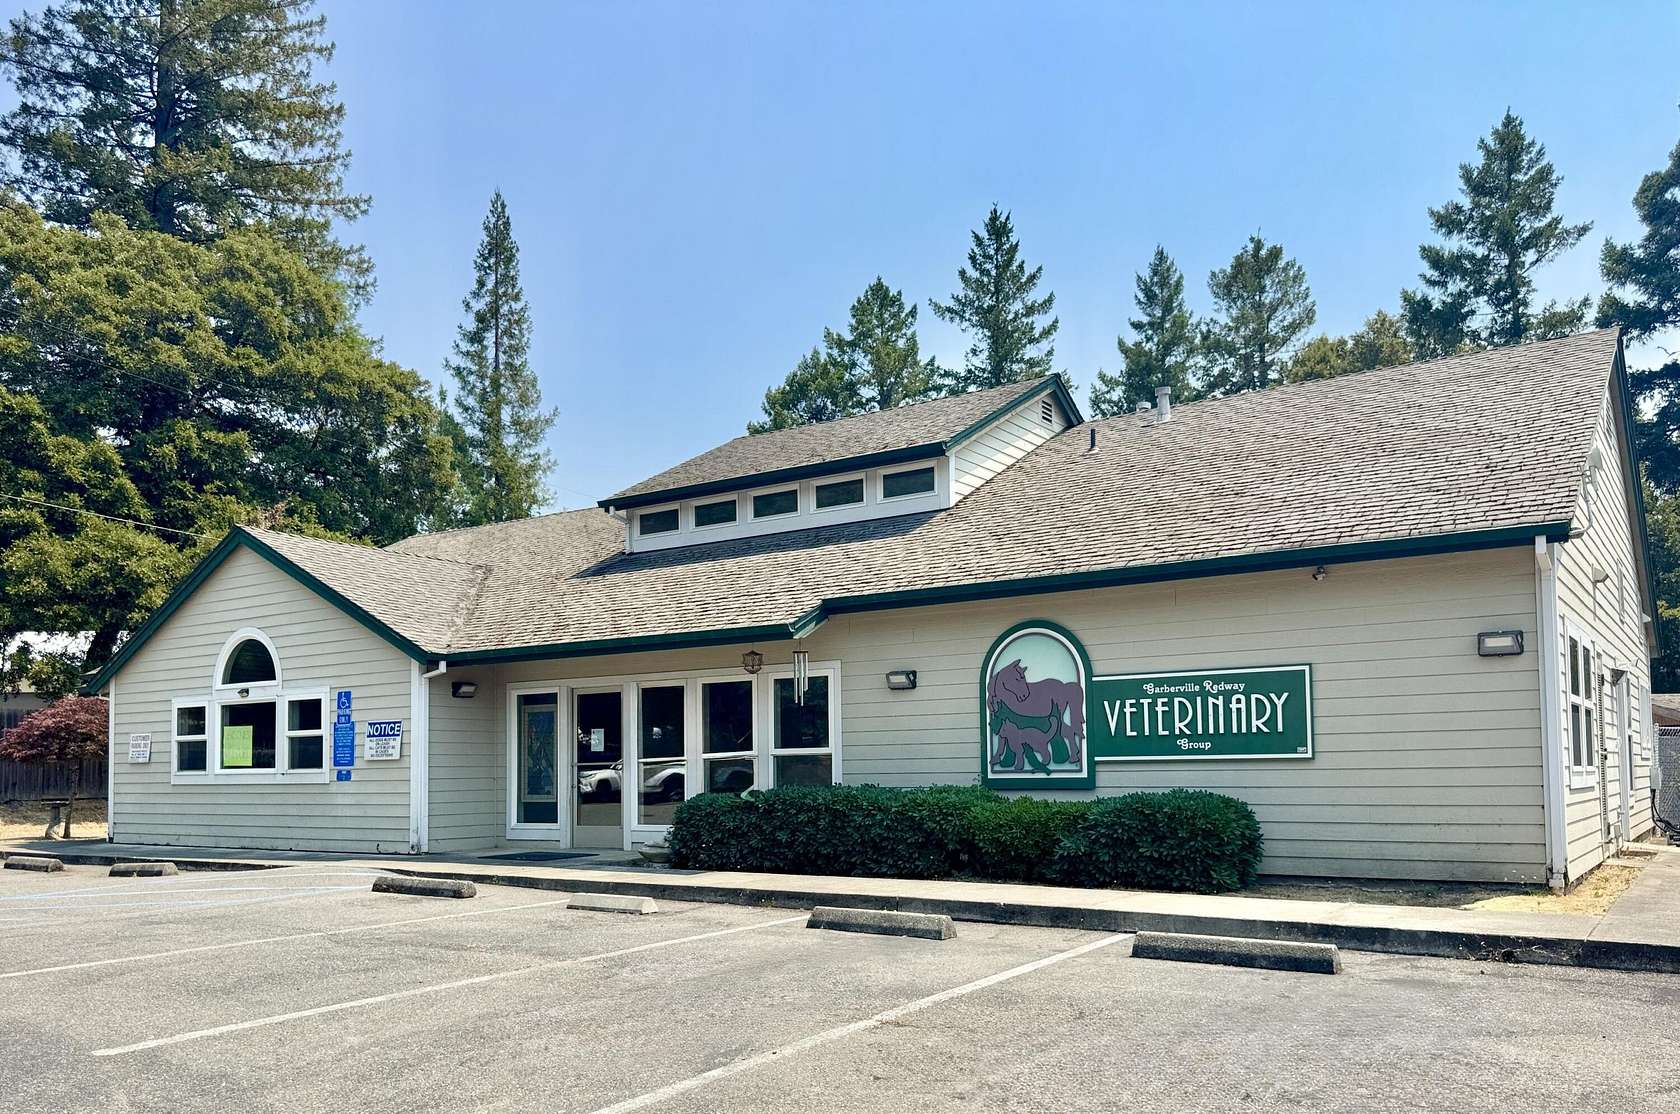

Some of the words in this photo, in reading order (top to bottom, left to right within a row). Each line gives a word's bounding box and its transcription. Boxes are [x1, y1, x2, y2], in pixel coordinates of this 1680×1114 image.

[1142, 682, 1200, 695] Garberville
[1203, 680, 1246, 693] Redway
[1103, 692, 1290, 737] VETERINARY
[367, 723, 401, 735] NOTICE
[1176, 738, 1212, 750] Group
